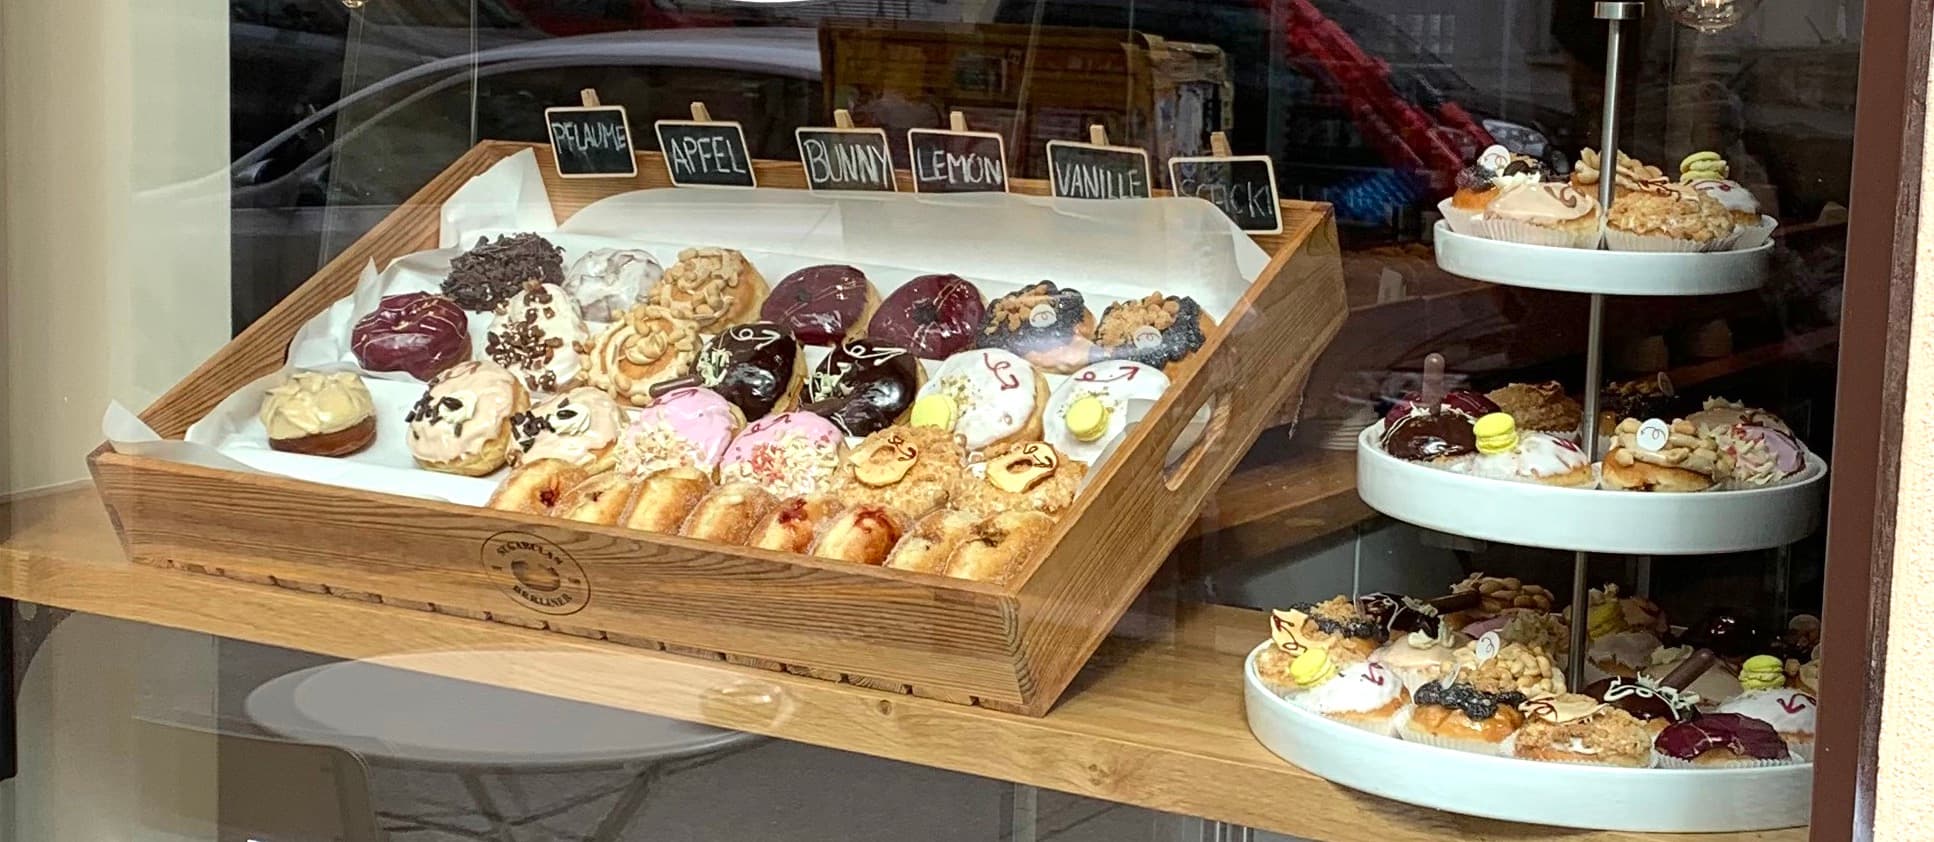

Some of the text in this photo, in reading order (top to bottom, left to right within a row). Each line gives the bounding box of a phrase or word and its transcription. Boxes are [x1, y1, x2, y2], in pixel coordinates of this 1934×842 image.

[552, 121, 626, 154] PFLAUME
[670, 136, 746, 174] APFEL
[803, 140, 890, 188] BUNNY
[916, 147, 1003, 185] LEMON
[1055, 163, 1143, 199] VANILLE
[513, 585, 572, 607] BERLINER
